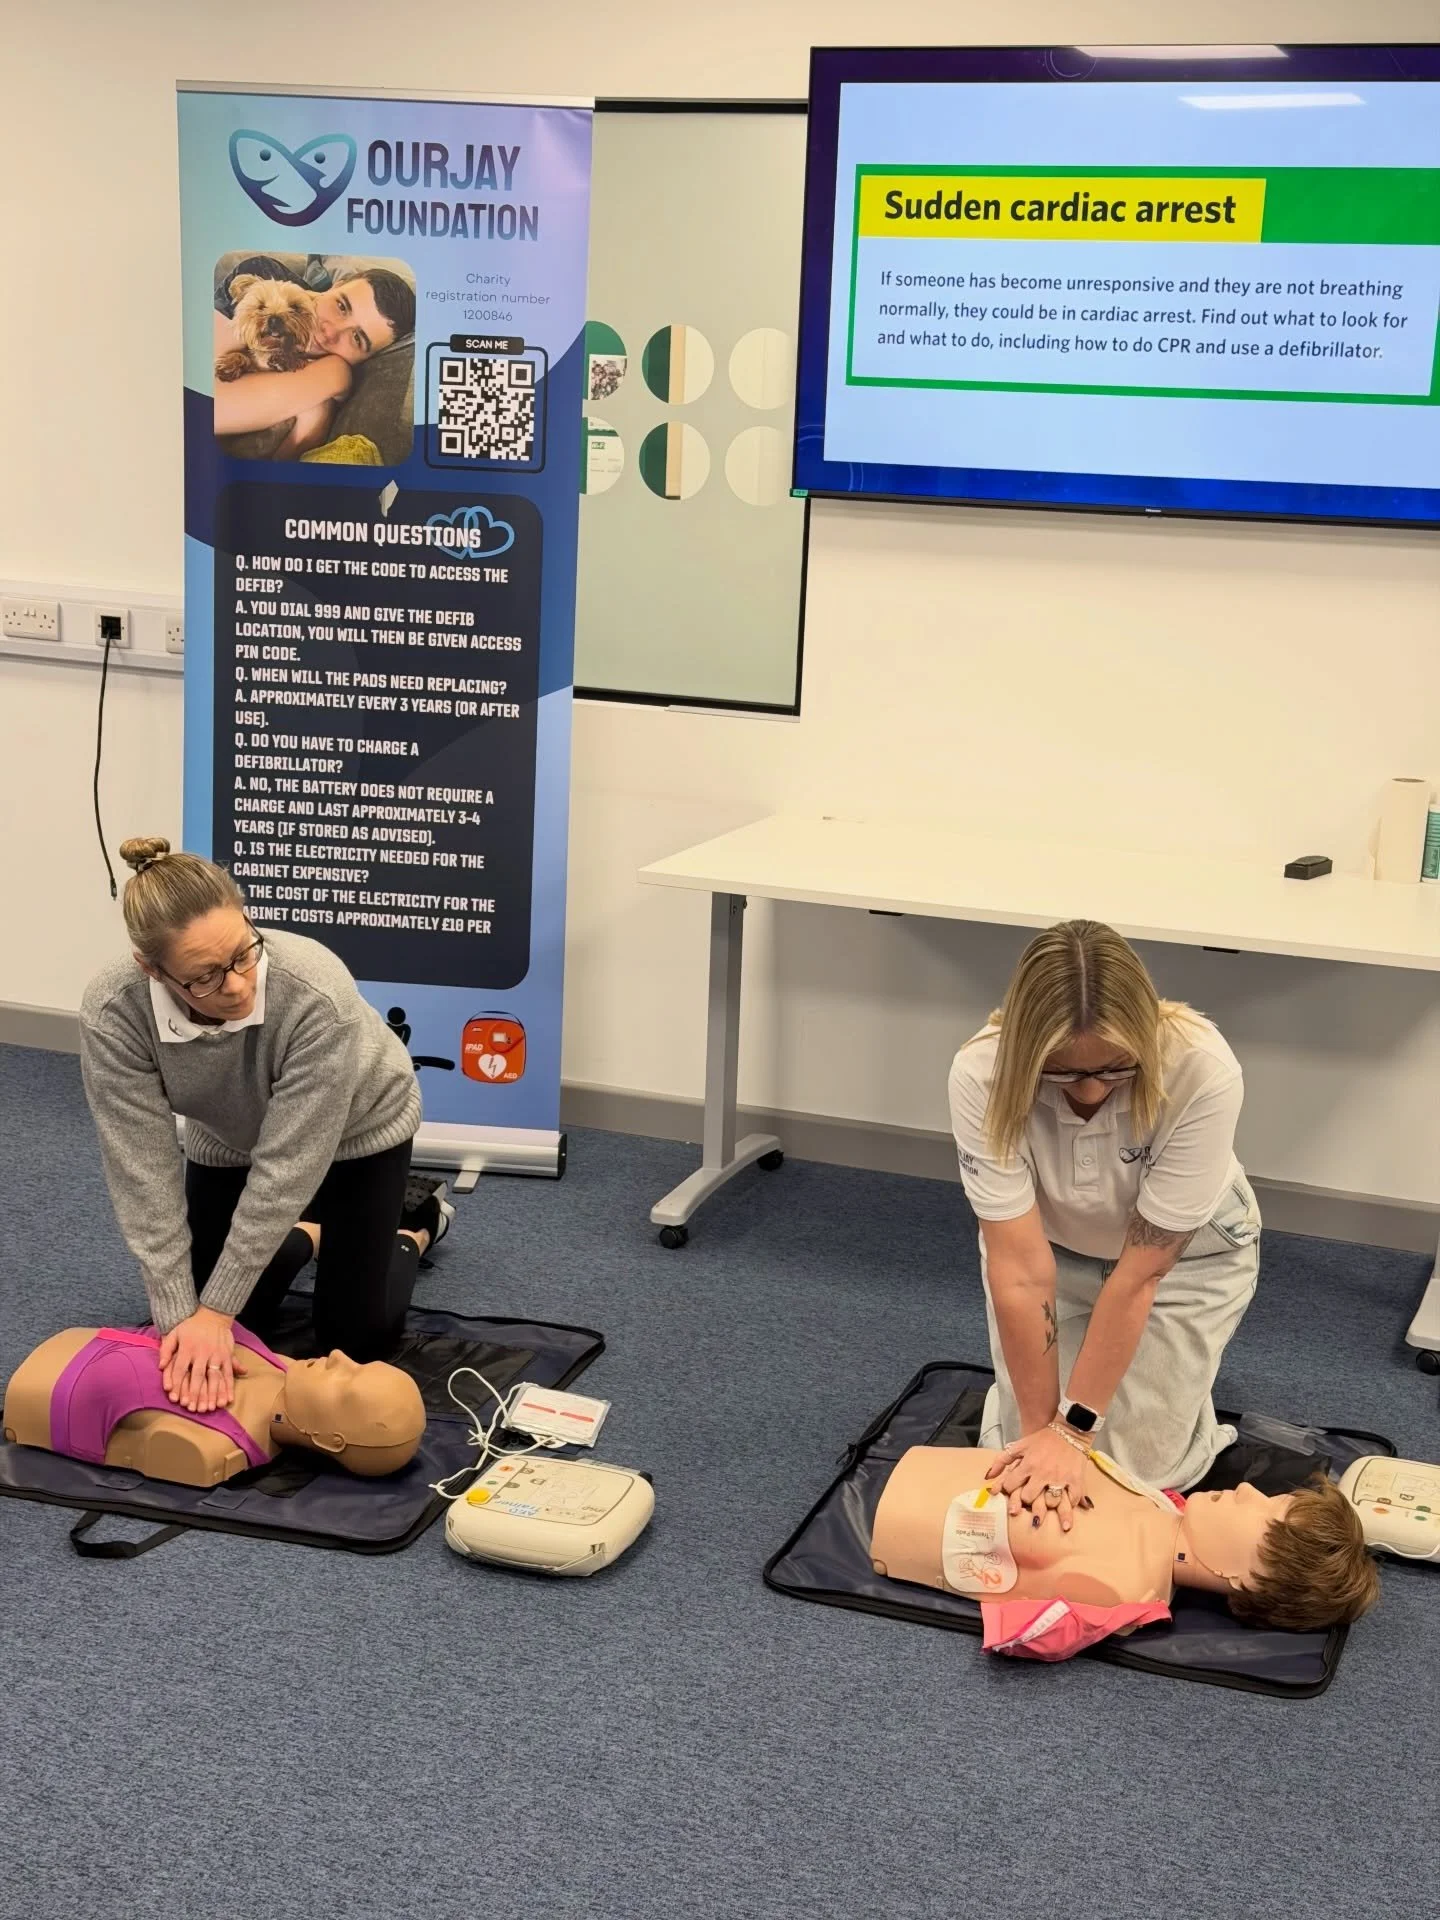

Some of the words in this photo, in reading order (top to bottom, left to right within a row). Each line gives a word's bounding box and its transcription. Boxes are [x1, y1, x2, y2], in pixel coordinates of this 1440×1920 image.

[368, 140, 521, 191] OURJAY
[347, 198, 539, 241] FOUNDATION
[885, 190, 1000, 220] Sudden
[1011, 192, 1126, 222] cardiac
[1136, 196, 1236, 223] arrest
[466, 273, 510, 287] Charity
[882, 271, 891, 285] If
[896, 275, 964, 287] someone
[970, 273, 995, 288] has
[1001, 274, 1061, 289] become
[1067, 277, 1174, 293] unresponsive
[1179, 278, 1209, 292] and
[1215, 278, 1250, 296] they
[1256, 283, 1281, 294] are
[1287, 281, 1314, 295] not
[1320, 280, 1403, 299] breathing
[426, 291, 496, 302] registration
[502, 295, 549, 304] number
[464, 310, 512, 321] 1200846
[880, 302, 948, 320] normally,
[955, 303, 987, 320] they
[992, 304, 1033, 319] could
[1039, 305, 1057, 320] be
[1063, 306, 1075, 320] in
[1081, 306, 1138, 322] cardiac
[1144, 309, 1195, 323] arrest.
[1202, 309, 1236, 324] Find
[1241, 311, 1268, 325] out
[1274, 310, 1314, 326] what
[1320, 312, 1336, 326] to
[1342, 311, 1377, 327] look
[1384, 312, 1407, 328] for
[465, 339, 493, 349] SCAN
[494, 340, 509, 350] ME
[878, 330, 904, 344] and
[910, 331, 946, 346] what
[952, 333, 966, 346] to
[971, 333, 993, 349] do,
[1000, 334, 1070, 353] including
[1075, 336, 1107, 350] how
[1113, 338, 1128, 351] to
[1133, 337, 1152, 352] do
[1158, 338, 1190, 353] CPR
[1196, 339, 1226, 354] and
[1232, 344, 1259, 355] use
[1265, 345, 1273, 355] a
[1279, 341, 1382, 358] defibrillator.
[285, 519, 367, 542] COMMON
[373, 523, 481, 549] QUESTIONS
[236, 555, 248, 571] Q.
[253, 556, 281, 570] HOW
[285, 558, 302, 572] DO
[307, 559, 312, 572] I
[316, 560, 340, 573] GET
[343, 561, 367, 575] THE
[372, 562, 406, 577] CODE
[409, 564, 426, 578] TO
[430, 566, 480, 581] ACCESS
[484, 568, 508, 583] THE
[236, 578, 283, 593] DEFIB?
[236, 600, 247, 613] A.
[251, 601, 276, 615] YOU
[281, 603, 311, 617] DIAL
[315, 604, 340, 618] 999
[344, 606, 370, 620] AND
[374, 608, 404, 622] GIVE
[408, 609, 432, 623] THE
[436, 611, 474, 626] DEFIB
[236, 622, 304, 641] LOCATION,
[308, 626, 333, 640] YOU
[337, 628, 368, 642] WILL
[371, 630, 404, 644] THEN
[409, 632, 424, 645] BE
[429, 633, 467, 648] GIVEN
[471, 635, 521, 651] ACCESS
[236, 645, 258, 659] PIN
[263, 646, 300, 661] CODE.
[236, 667, 248, 682] Q.
[252, 668, 287, 682] WHEN
[292, 670, 322, 684] WILL
[325, 672, 349, 686] THE
[353, 673, 386, 688] PADS
[391, 675, 423, 690] NEED
[428, 677, 506, 694] REPLACING?
[235, 689, 247, 702] A.
[251, 690, 355, 708] APPROXIMATELY
[358, 696, 397, 710] EVERY
[400, 698, 408, 711] 3
[411, 699, 451, 713] YEARS
[480, 703, 519, 717] AFTER
[235, 733, 247, 748] Q.
[252, 734, 268, 747] DO
[272, 735, 297, 749] YOU
[302, 736, 333, 751] HAVE
[337, 738, 353, 752] TO
[357, 740, 407, 755] CHARGE
[411, 743, 419, 756] A
[235, 755, 343, 773] DEFIBRILLATOR?
[235, 776, 246, 789] A.
[250, 777, 271, 793] NO,
[275, 779, 299, 792] THE
[303, 780, 357, 795] BATTERY
[361, 783, 394, 798] DOES
[399, 786, 424, 799] NOT
[427, 787, 482, 803] REQUIRE
[486, 791, 493, 804] A
[235, 798, 285, 813] CHARGE
[288, 801, 314, 815] AND
[318, 803, 349, 817] LAST
[352, 805, 455, 823] APPROXIMATELY
[459, 811, 480, 825] 3-4
[234, 820, 274, 834] YEARS
[299, 823, 348, 838] STORED
[352, 827, 368, 840] AS
[235, 841, 246, 856] Q.
[250, 842, 264, 855] IS
[268, 843, 292, 856] THE
[296, 844, 377, 861] ELECTRICITY
[380, 850, 429, 865] NEEDED
[433, 853, 457, 867] FOR
[460, 855, 484, 868] THE
[234, 863, 289, 878] CABINET
[293, 866, 369, 882] EXPENSIVE?
[248, 885, 272, 898] THE
[276, 886, 309, 900] COST
[313, 888, 329, 901] OF
[332, 890, 355, 903] THE
[359, 891, 440, 908] ELECTRICITY
[444, 897, 468, 910] FOR
[471, 899, 495, 912] THE
[242, 905, 289, 922] ABINET
[292, 909, 333, 923] COSTS
[337, 911, 439, 930] APPROXIMATELY
[442, 918, 463, 932] £10
[468, 920, 491, 933] PER
